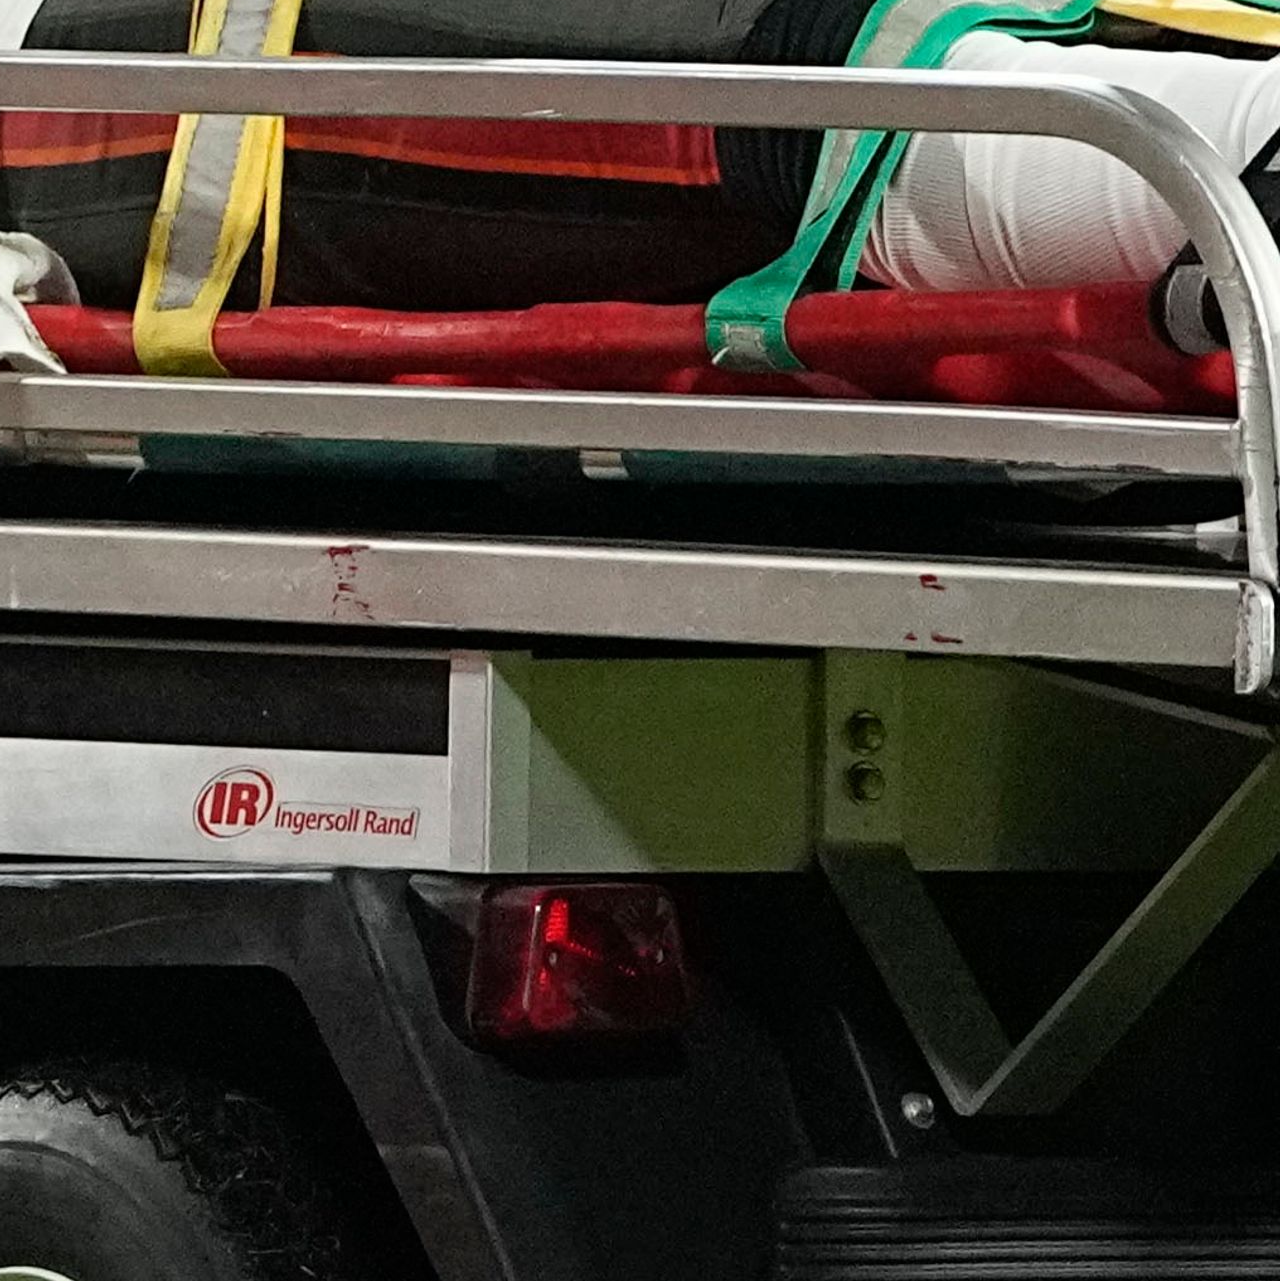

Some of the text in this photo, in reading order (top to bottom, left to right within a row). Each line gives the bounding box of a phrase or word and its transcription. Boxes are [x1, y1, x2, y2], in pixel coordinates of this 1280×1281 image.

[209, 782, 261, 826] IR
[274, 806, 416, 836] Ingersoll Rand
